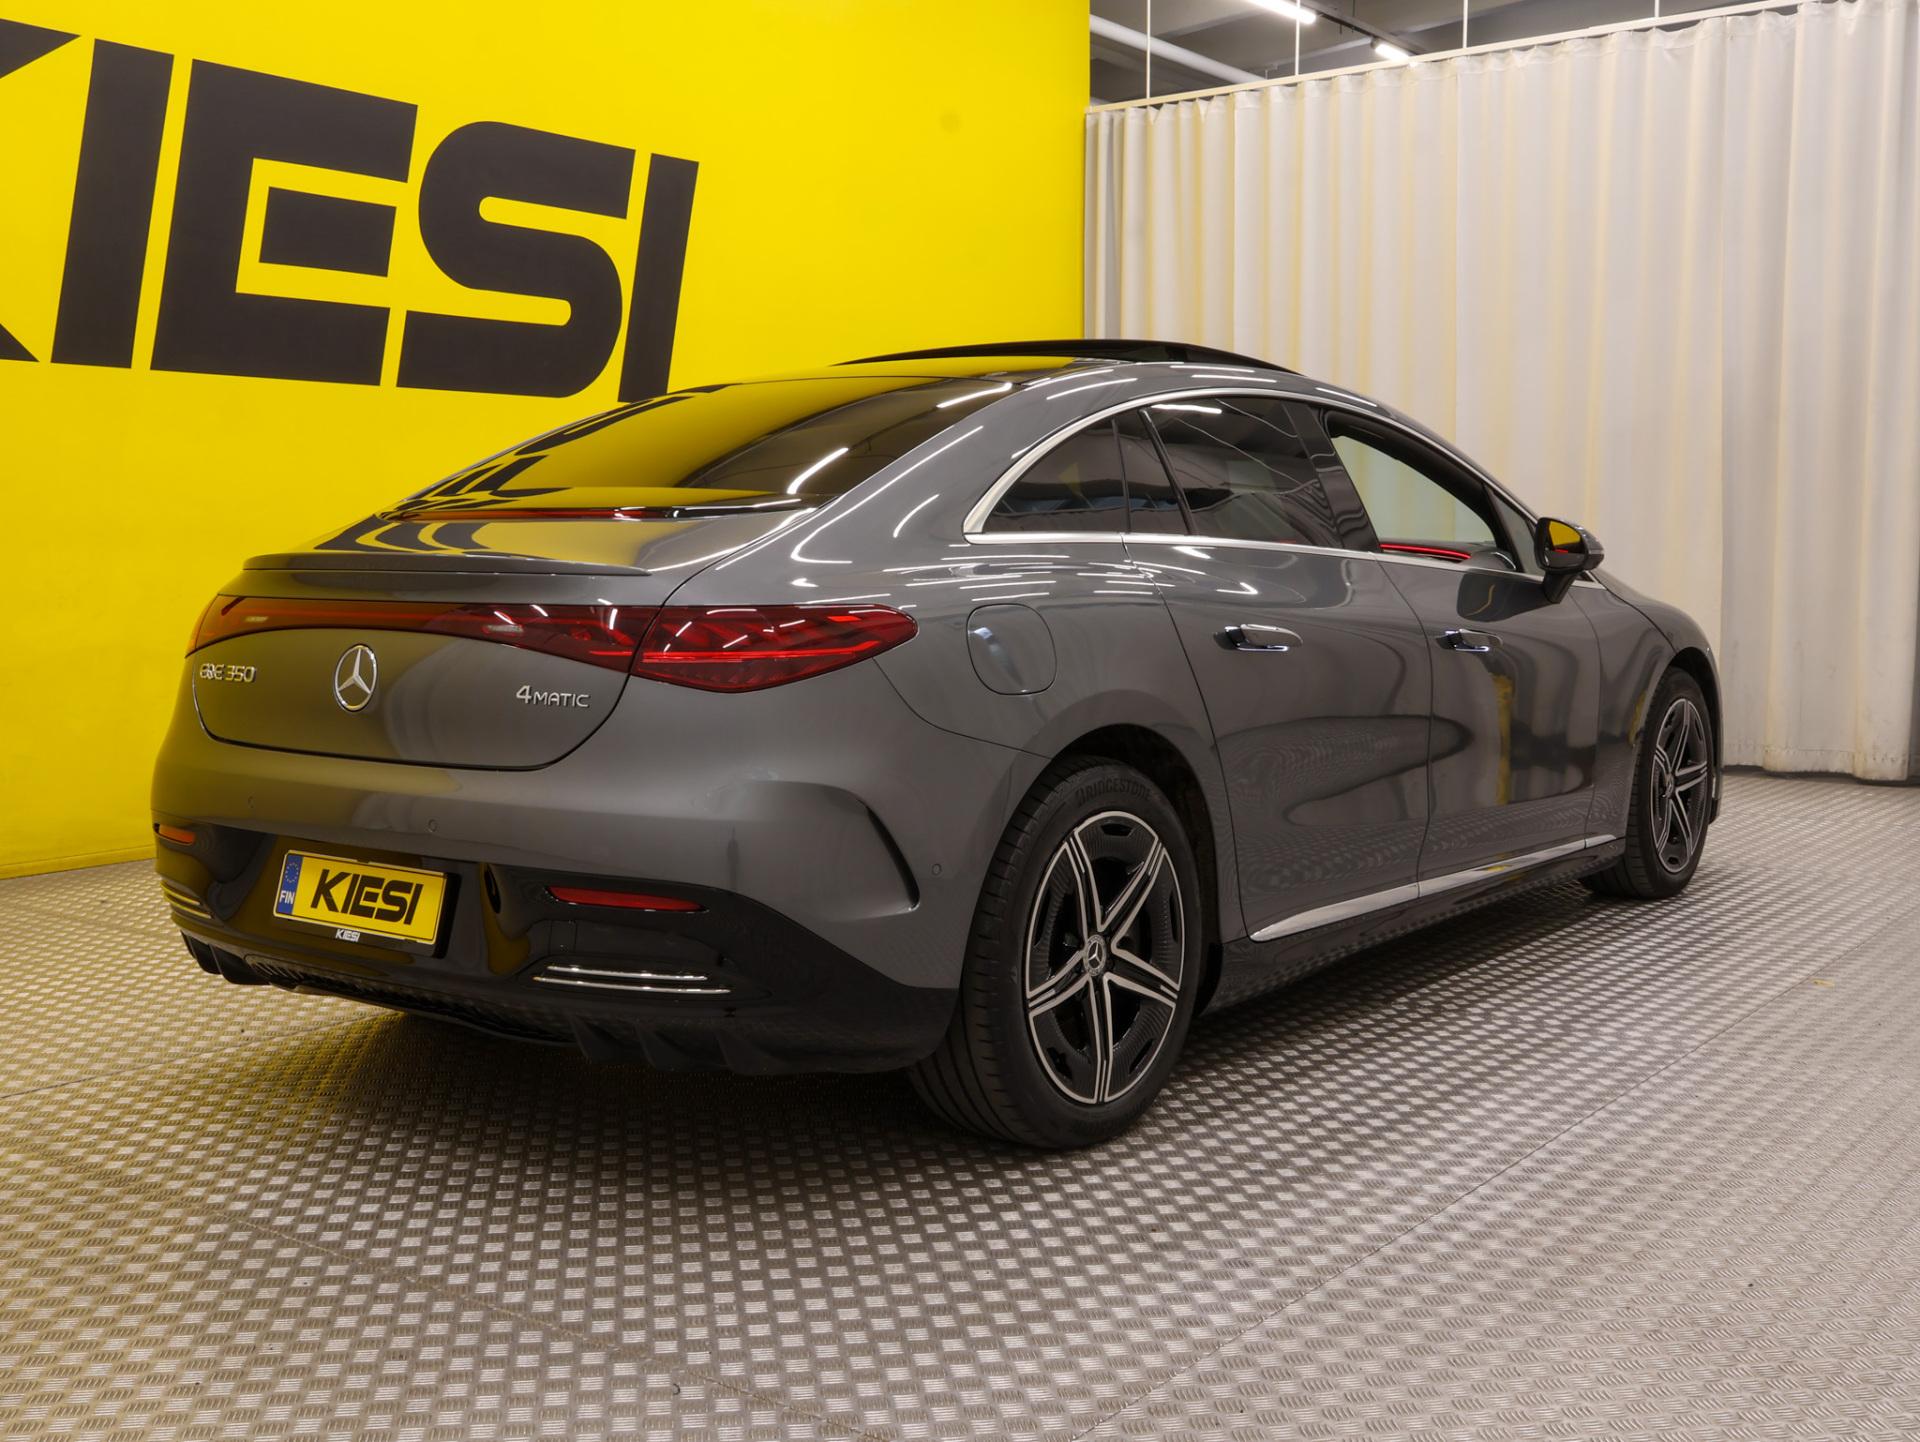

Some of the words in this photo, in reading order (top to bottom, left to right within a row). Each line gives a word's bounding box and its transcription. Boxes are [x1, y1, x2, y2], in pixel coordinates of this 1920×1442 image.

[0, 19, 699, 403] IESI
[225, 664, 256, 683] 350
[516, 685, 589, 707] 4MATIC
[279, 890, 295, 905] FIN
[310, 868, 424, 925] KIESI
[335, 928, 361, 943] KIESI
